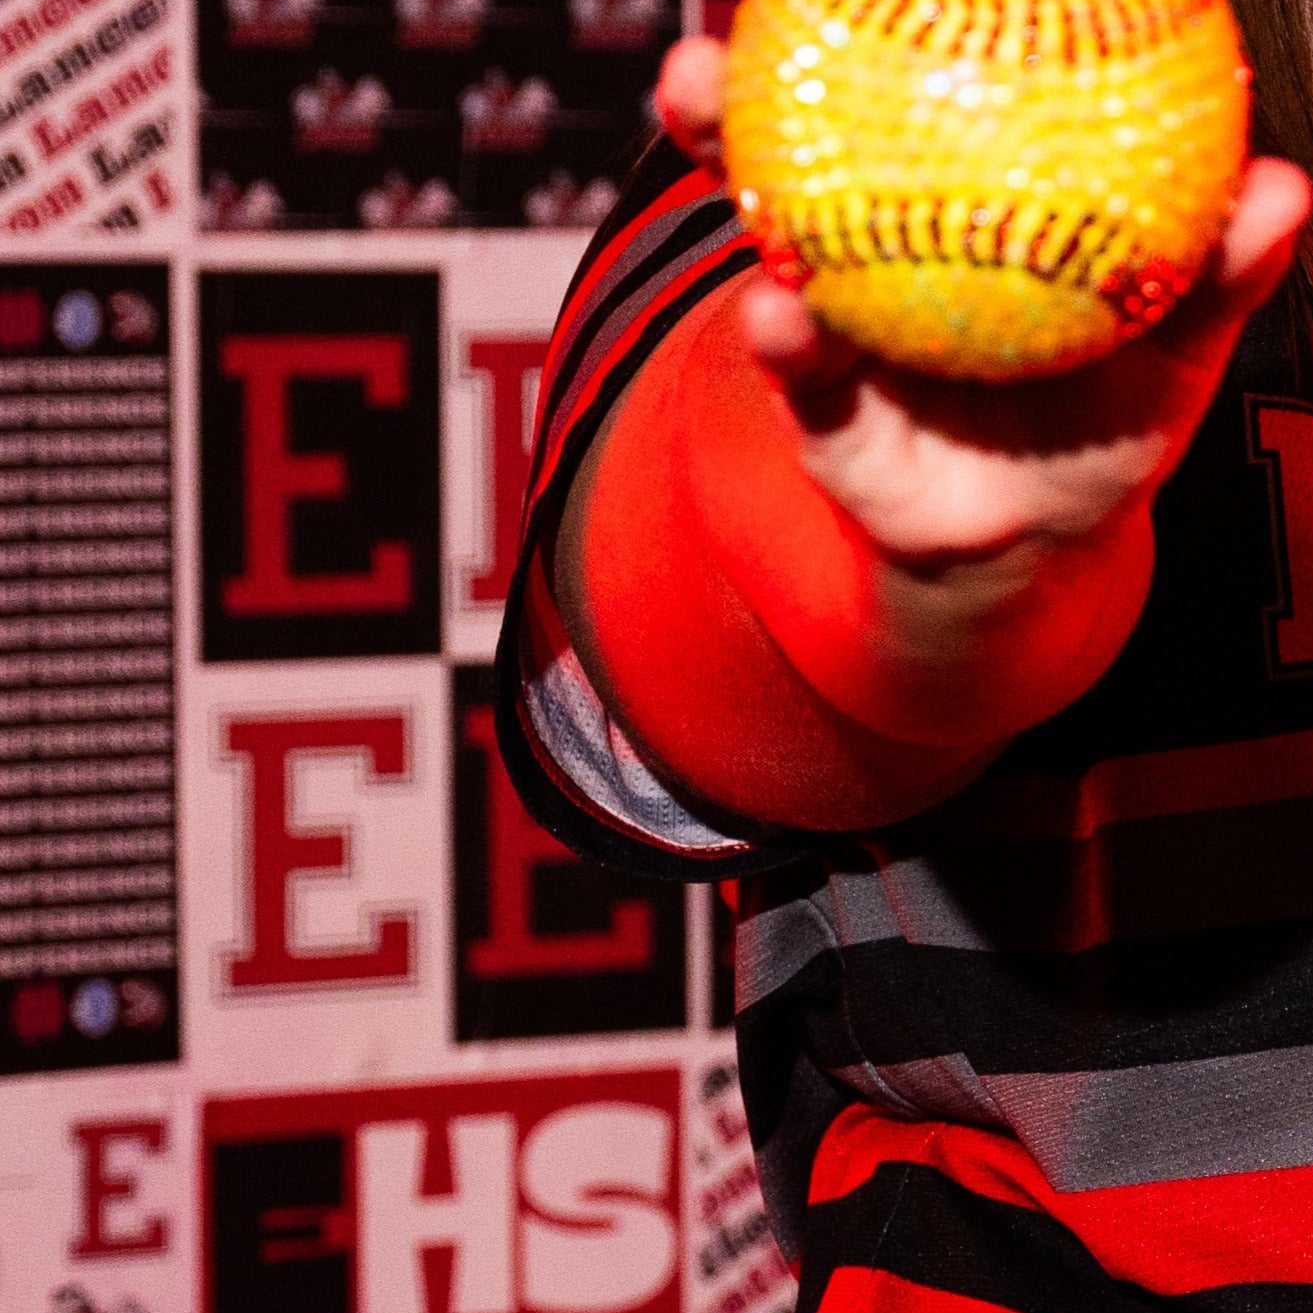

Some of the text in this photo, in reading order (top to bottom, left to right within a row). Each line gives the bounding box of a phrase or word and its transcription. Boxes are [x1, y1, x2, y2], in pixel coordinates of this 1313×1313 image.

[220, 335, 411, 616] E
[218, 708, 415, 998] E
[69, 1117, 172, 1262] E
